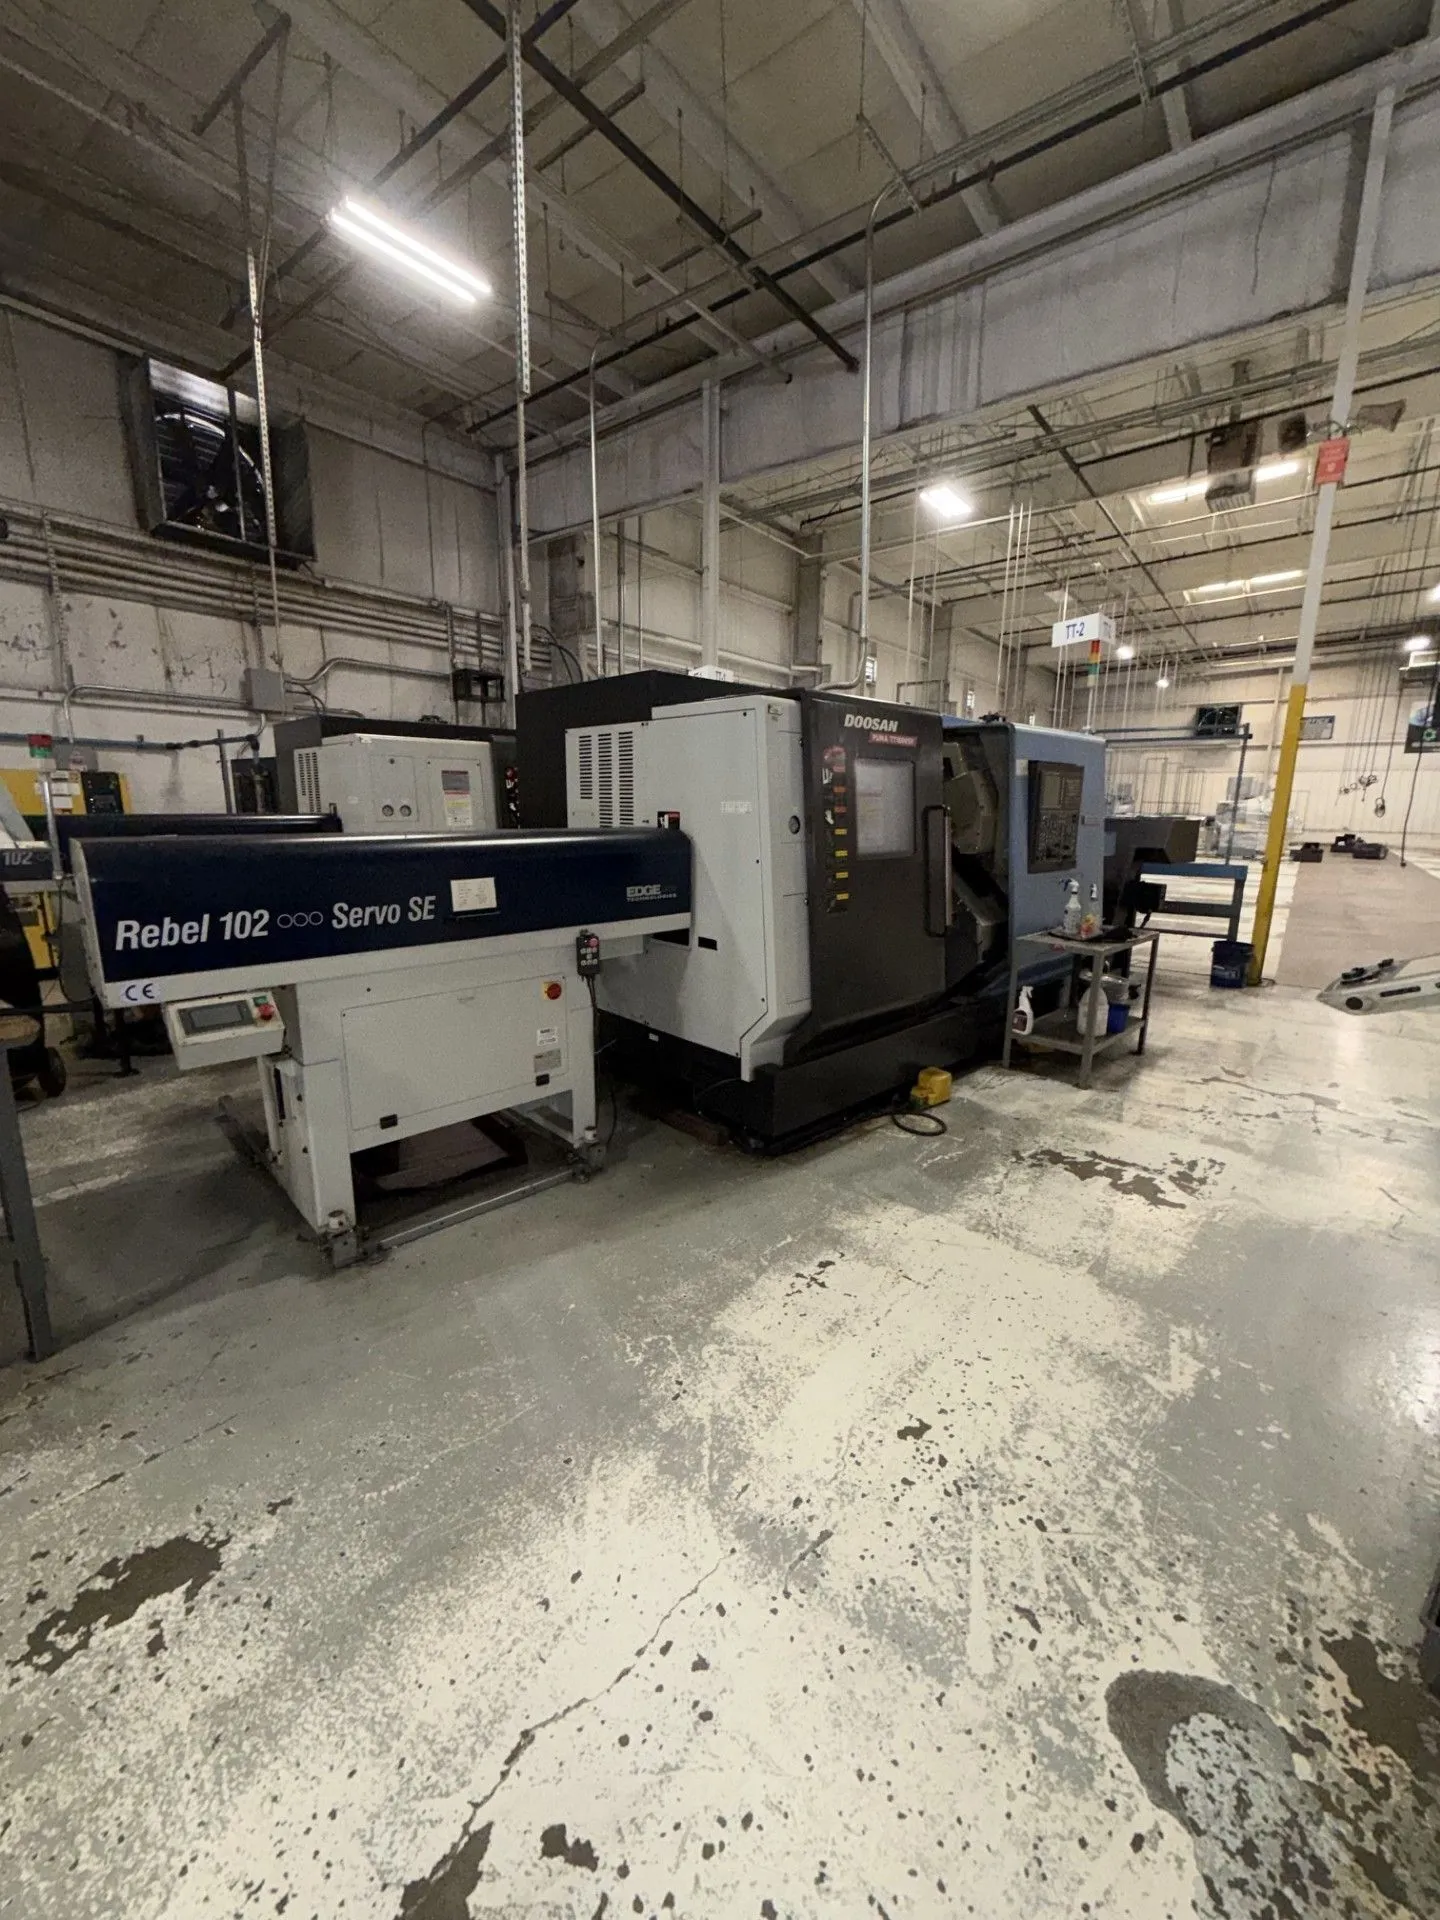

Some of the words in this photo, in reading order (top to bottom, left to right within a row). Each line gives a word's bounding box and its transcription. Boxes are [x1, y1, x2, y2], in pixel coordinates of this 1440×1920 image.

[1066, 622, 1085, 639] TT-2
[844, 713, 899, 732] DOOSAN
[2, 851, 33, 866] 102
[626, 884, 662, 898] EDGE
[115, 913, 210, 951] Rebel
[219, 909, 270, 941] 102
[332, 902, 401, 930] Servo
[407, 895, 437, 922] SE
[125, 982, 155, 1002] CE
